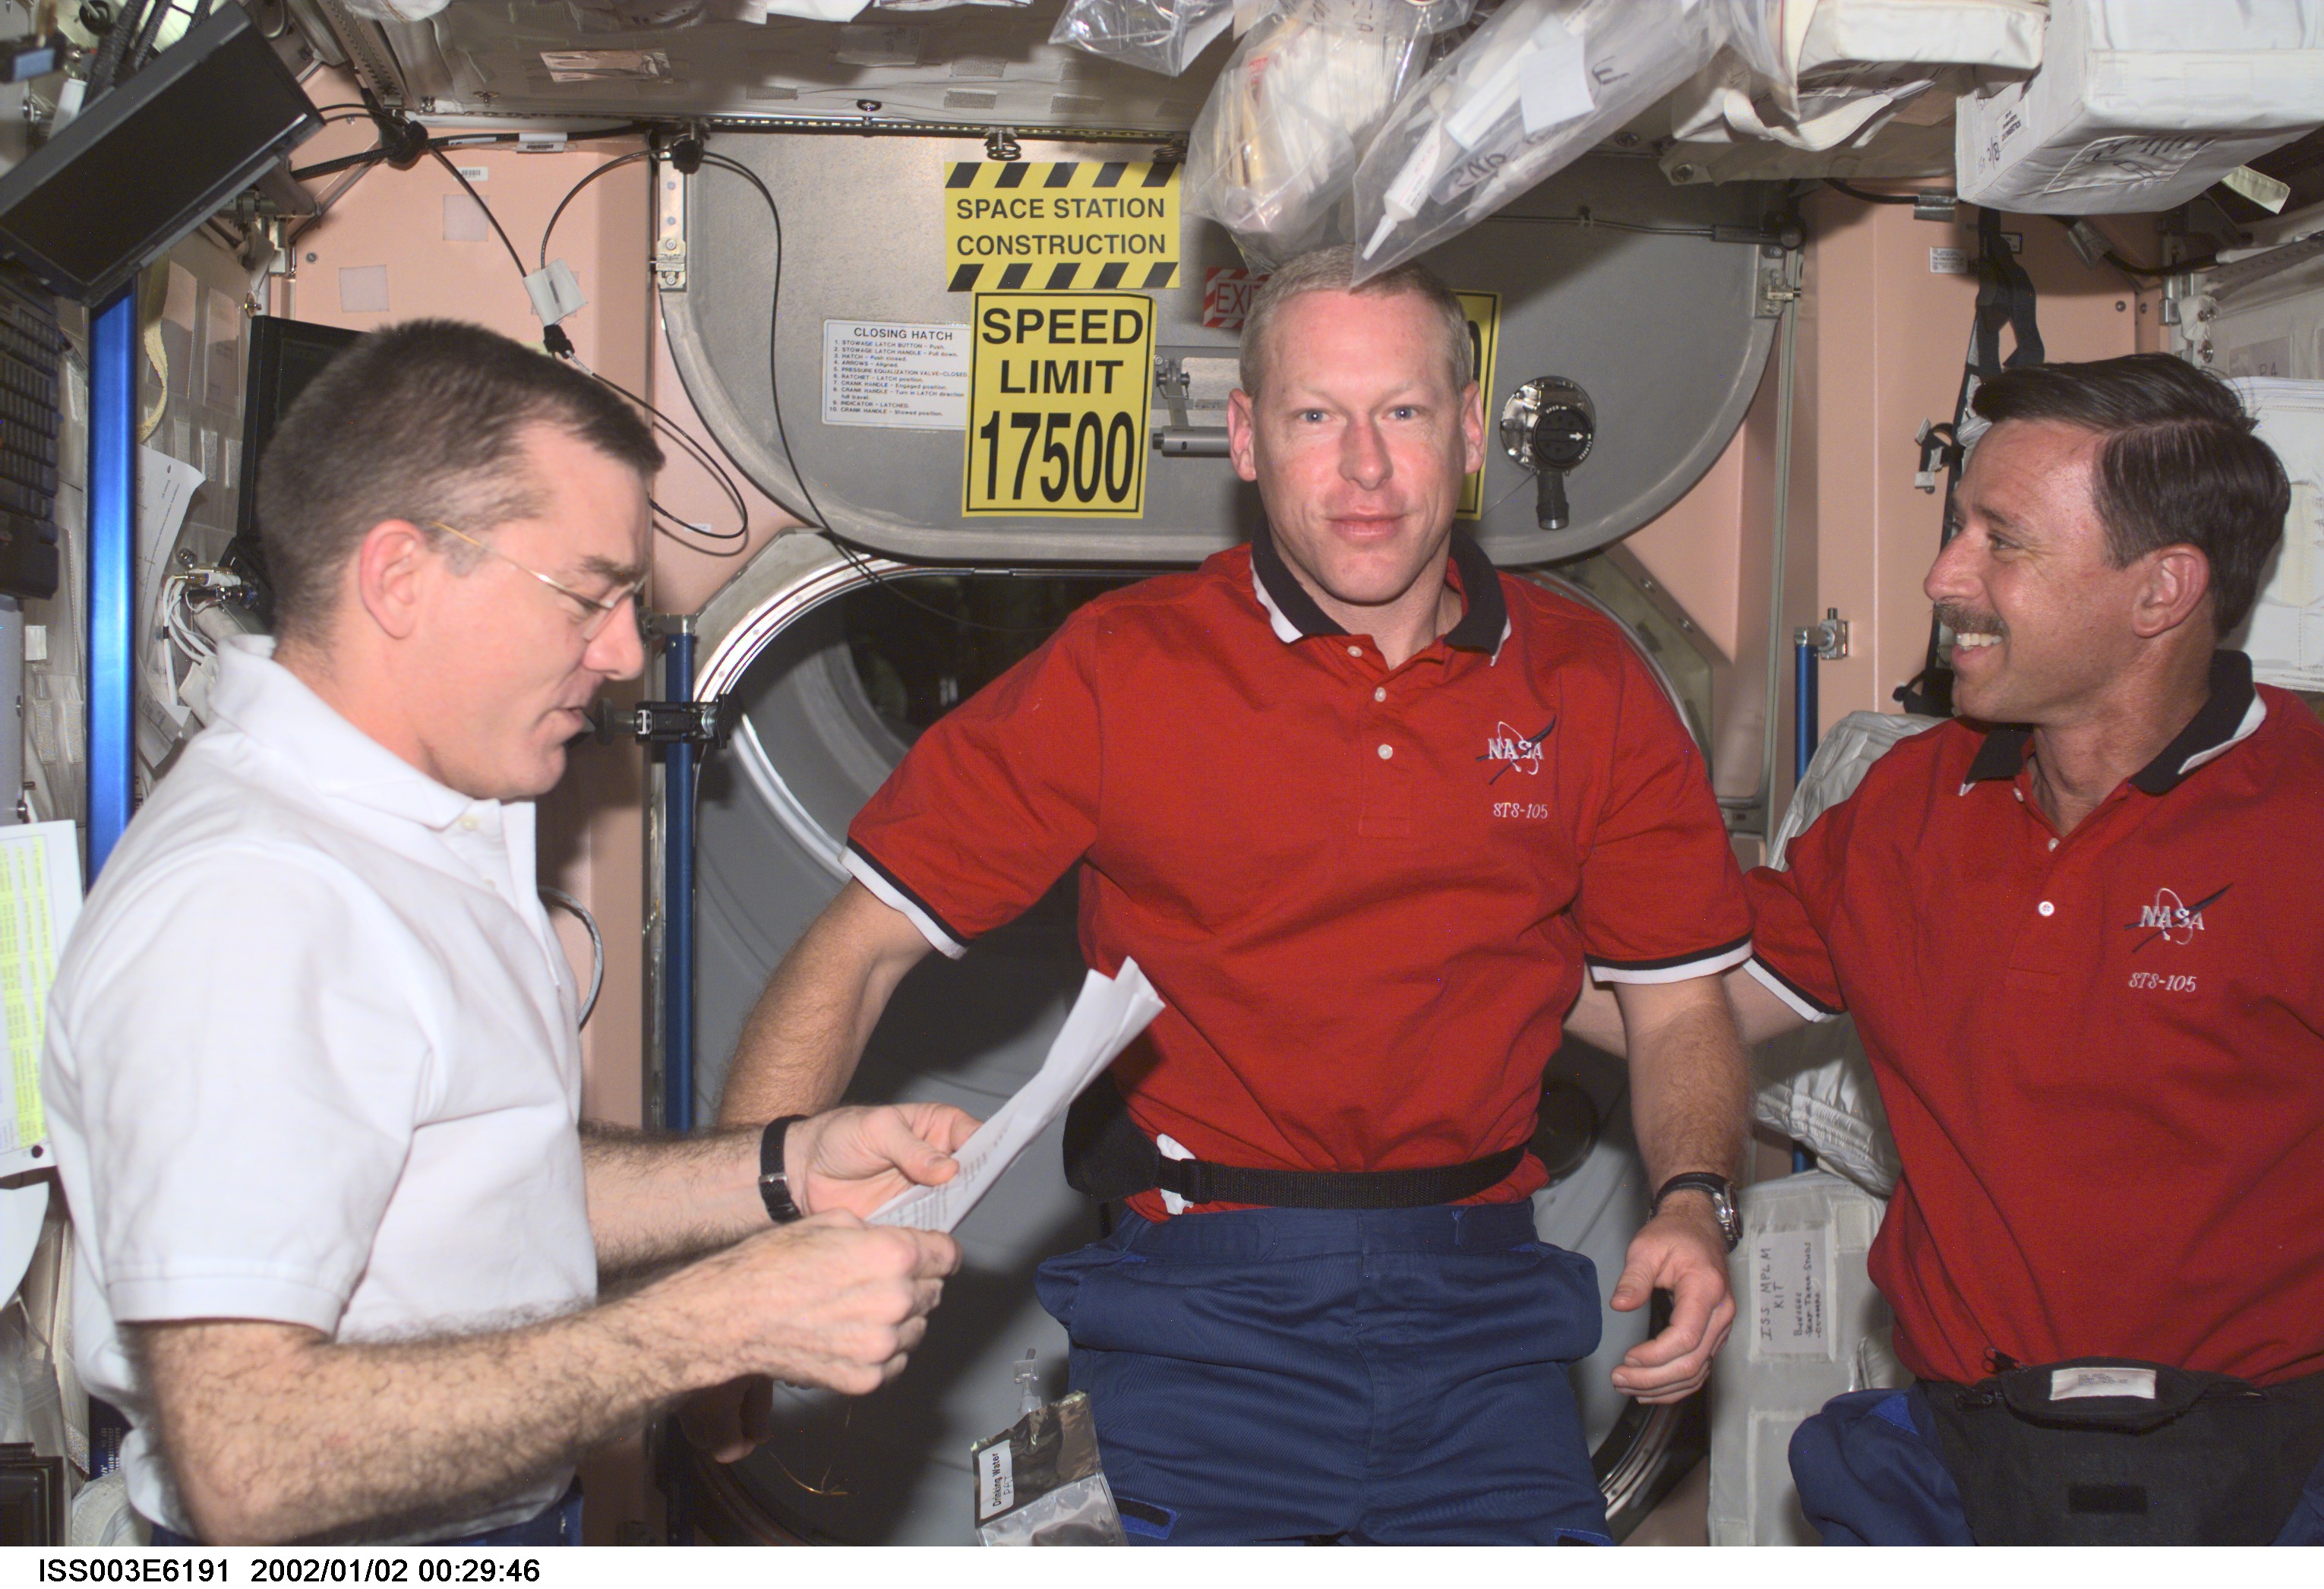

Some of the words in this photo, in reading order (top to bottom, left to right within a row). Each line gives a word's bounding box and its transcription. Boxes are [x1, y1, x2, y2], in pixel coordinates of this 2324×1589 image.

[957, 198, 1044, 219] SPACE
[1054, 197, 1164, 218] STATION
[957, 233, 1165, 255] CONSTRUCTION
[854, 327, 907, 339] CLOSING
[911, 331, 952, 340] HATCH
[982, 308, 1143, 344] SPEED
[1000, 360, 1124, 393] LIMIT
[980, 411, 1135, 503] 17500
[1488, 738, 1545, 760] NASA
[1493, 802, 1548, 819] STS-105
[2139, 905, 2205, 930] NASA
[2128, 972, 2197, 992] STS-105
[1773, 1281, 1786, 1309] KIT
[1760, 1307, 1773, 1341] ISS
[991, 1452, 1001, 1477] Water
[992, 1476, 1003, 1507] Drinking
